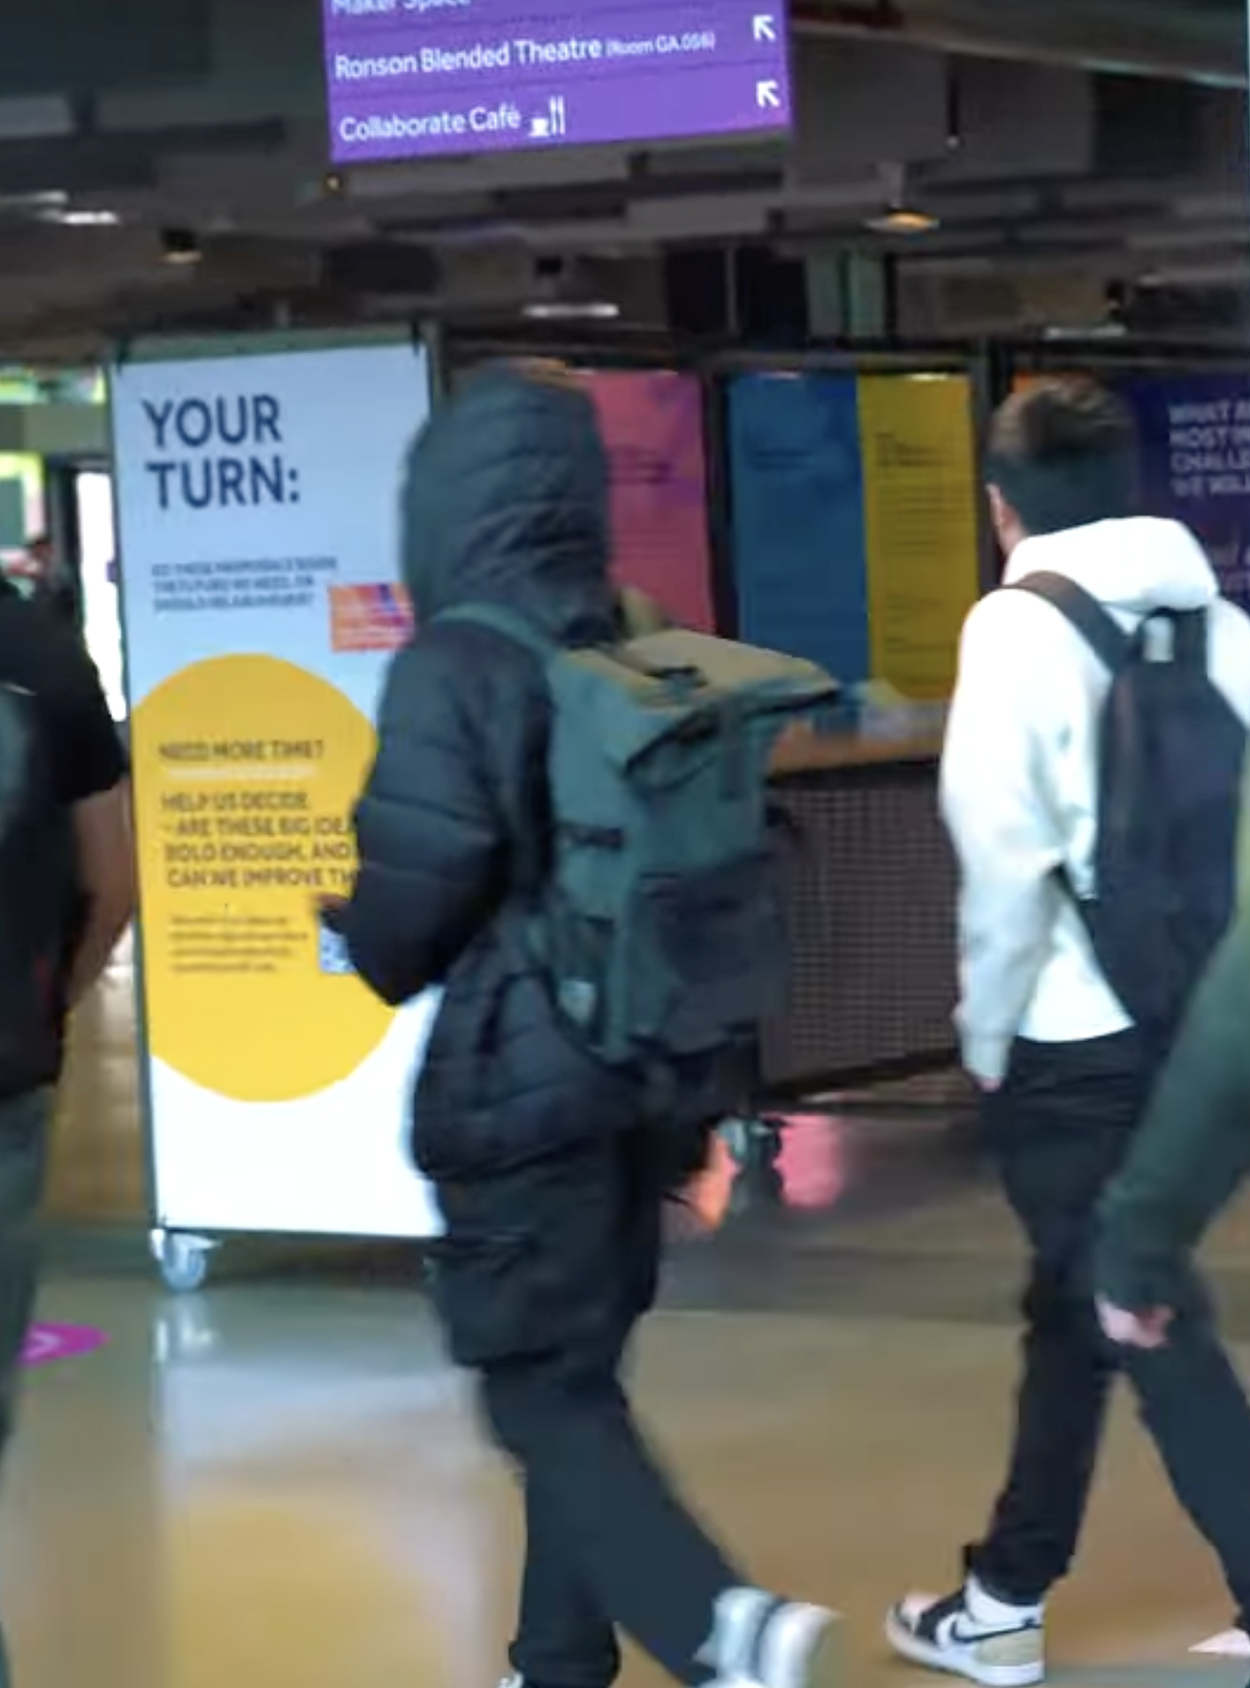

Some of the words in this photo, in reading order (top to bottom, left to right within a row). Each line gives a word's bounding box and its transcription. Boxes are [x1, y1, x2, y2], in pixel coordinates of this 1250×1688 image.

[335, 53, 417, 79] Ronson
[420, 41, 509, 72] Blended
[513, 36, 602, 64] Theatre
[340, 110, 466, 141] Collaborate
[469, 103, 522, 131] Café
[141, 393, 283, 448] YOUR
[145, 454, 300, 510] TURN:
[213, 740, 264, 761] MORE
[271, 738, 324, 758] TIME?
[161, 792, 208, 812] HELP
[214, 792, 236, 810] US
[241, 791, 308, 810] DECIDE
[176, 818, 211, 836] ARE
[218, 817, 275, 836] THESE
[279, 816, 310, 834] BIG
[165, 844, 216, 862] BOLD
[312, 841, 351, 860] AND
[242, 868, 323, 887] IMPROVE
